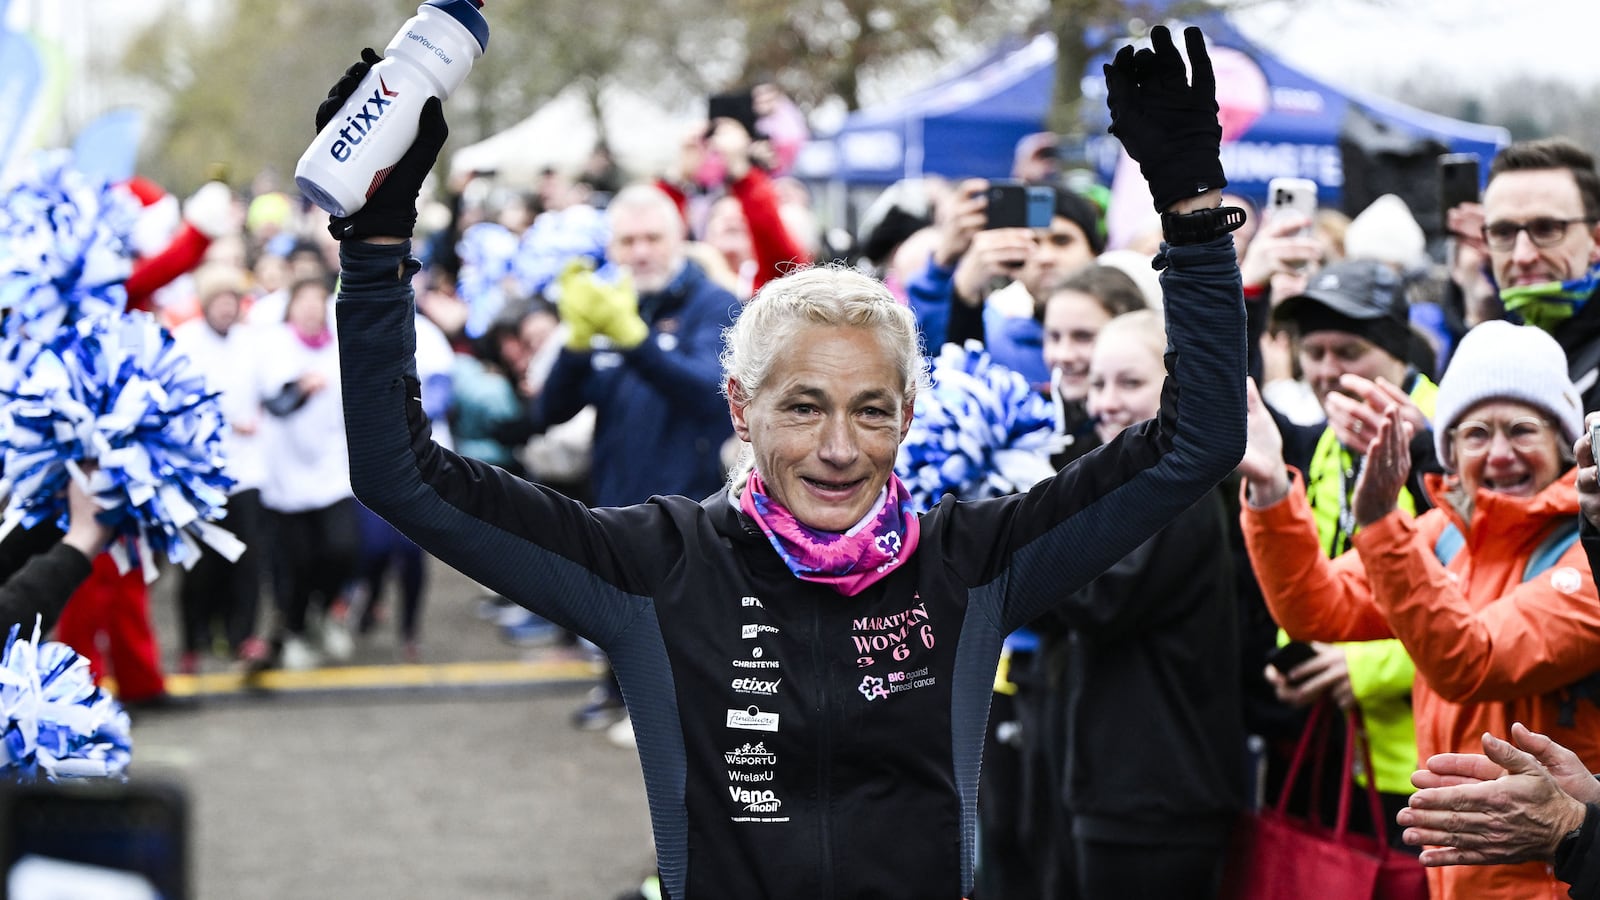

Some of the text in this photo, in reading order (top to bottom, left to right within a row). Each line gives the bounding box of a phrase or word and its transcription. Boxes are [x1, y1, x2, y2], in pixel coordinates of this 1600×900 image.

[330, 88, 393, 163] etixx
[757, 625, 780, 633] SPORT
[732, 660, 780, 668] CHRISTEYNS
[887, 666, 929, 683] BIG against
[731, 677, 774, 693] etixx
[889, 677, 936, 693] breast cancer
[728, 770, 774, 782] WrelaxU
[728, 785, 775, 803] Vano
[749, 802, 778, 813] mobil
